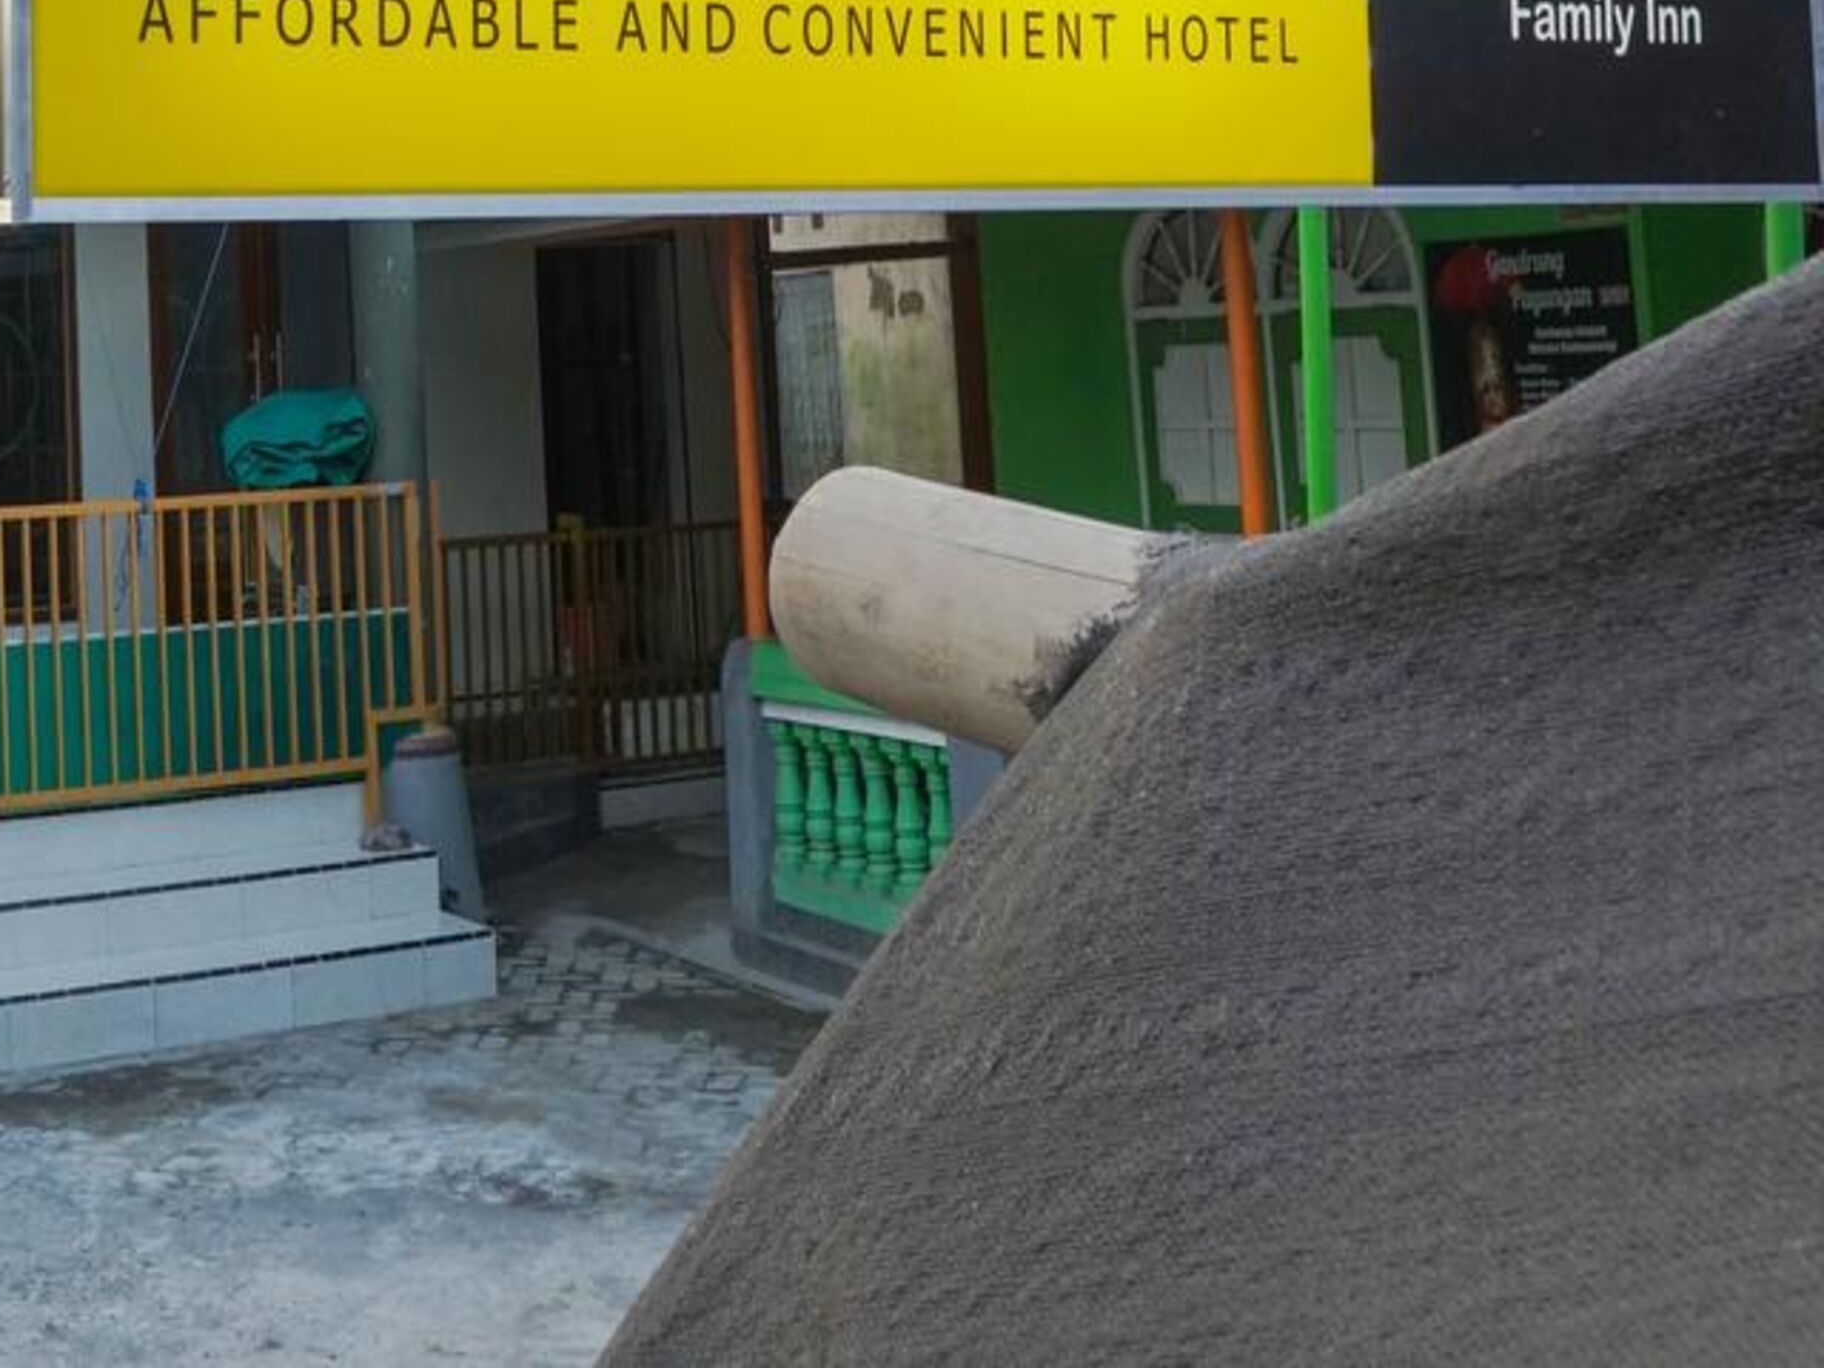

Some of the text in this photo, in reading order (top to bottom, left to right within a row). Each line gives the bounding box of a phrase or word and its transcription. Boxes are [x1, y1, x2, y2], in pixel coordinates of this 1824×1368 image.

[616, 0, 736, 54] AND
[762, 3, 1116, 61] CONVENIENT
[1144, 16, 1298, 64] HOTEL
